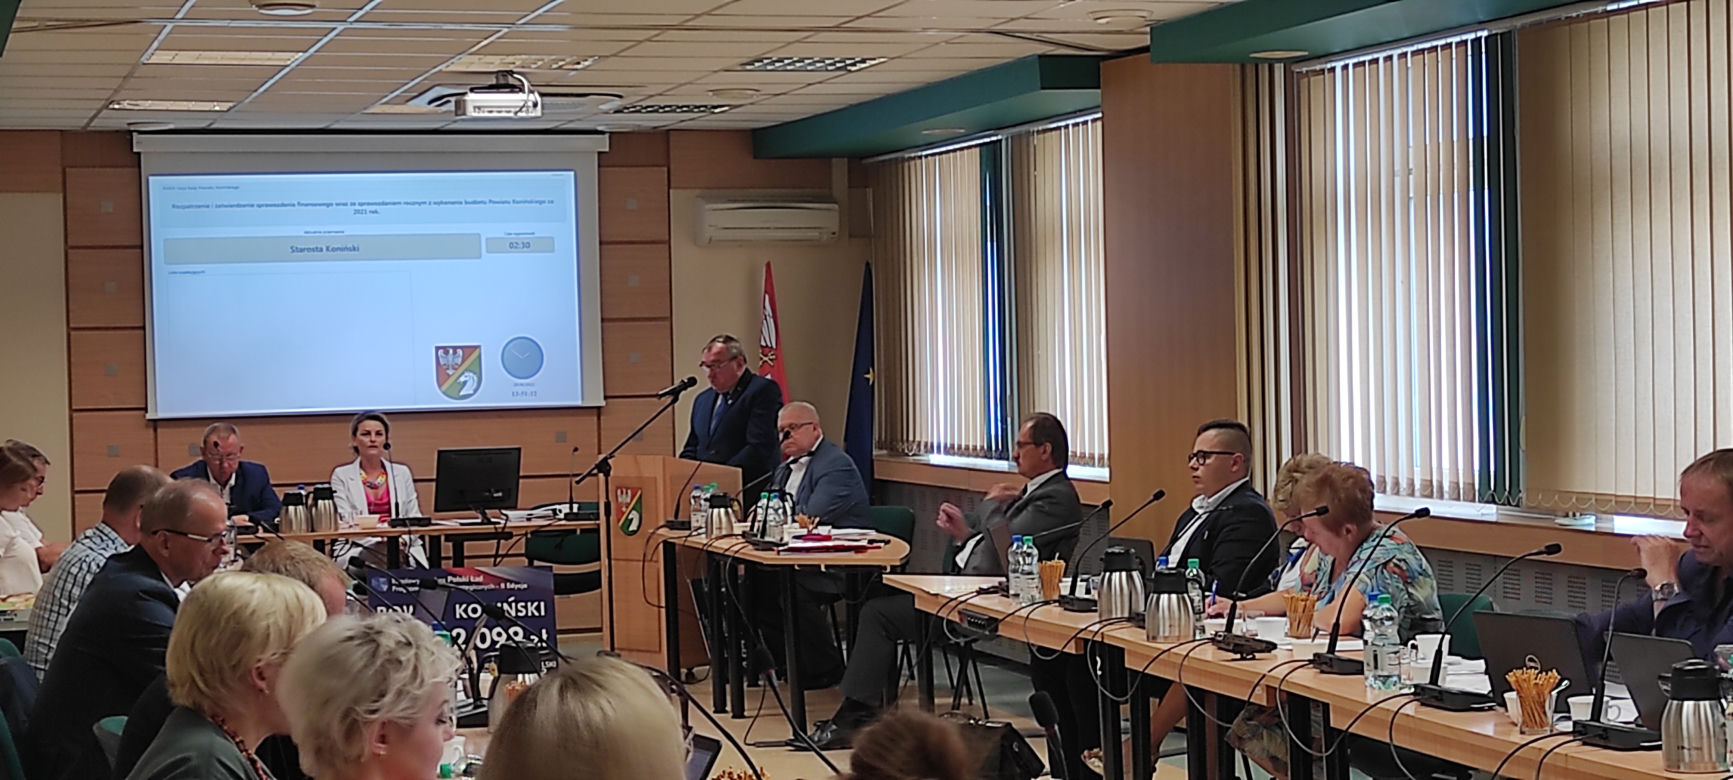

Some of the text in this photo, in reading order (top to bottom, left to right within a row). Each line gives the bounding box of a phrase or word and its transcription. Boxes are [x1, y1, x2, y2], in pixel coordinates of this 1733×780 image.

[289, 243, 360, 253] Starosta Koniński
[447, 575, 469, 583] Polski
[506, 582, 528, 591] Edycja
[455, 596, 546, 619] KOŃSKI
